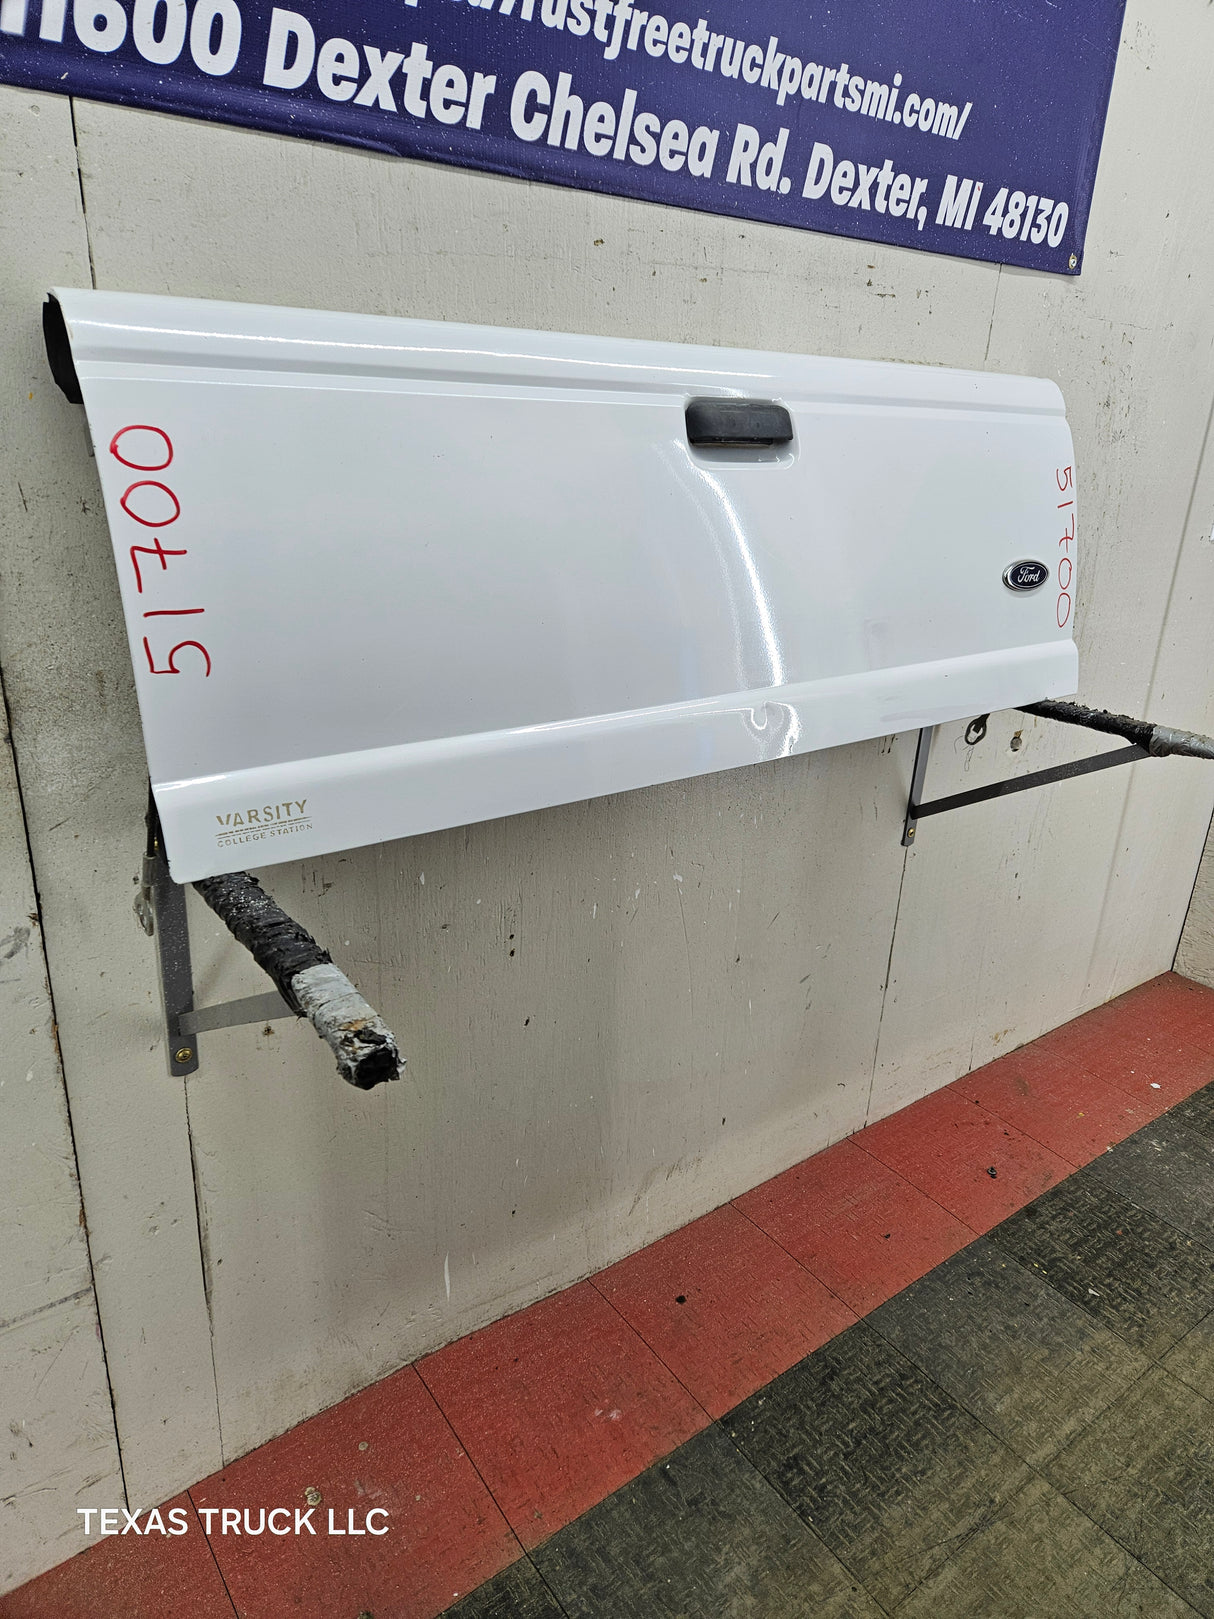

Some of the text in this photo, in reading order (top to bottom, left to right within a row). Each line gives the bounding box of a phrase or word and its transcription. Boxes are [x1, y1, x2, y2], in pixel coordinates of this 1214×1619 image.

[263, 6, 496, 130] Dexter
[510, 70, 719, 179] Chelsea
[726, 123, 791, 195] Rd.
[802, 142, 928, 231] Dexter,
[935, 175, 983, 230] MI
[983, 187, 1069, 248] 48130
[404, 0, 972, 141] ustfreetruckpartsmi.com/
[110, 424, 211, 677] 51700
[1017, 566, 1041, 583] Ford
[1056, 466, 1075, 628] 51700
[216, 799, 307, 827] VARSITY
[217, 823, 313, 848] COLLEGE STATION
